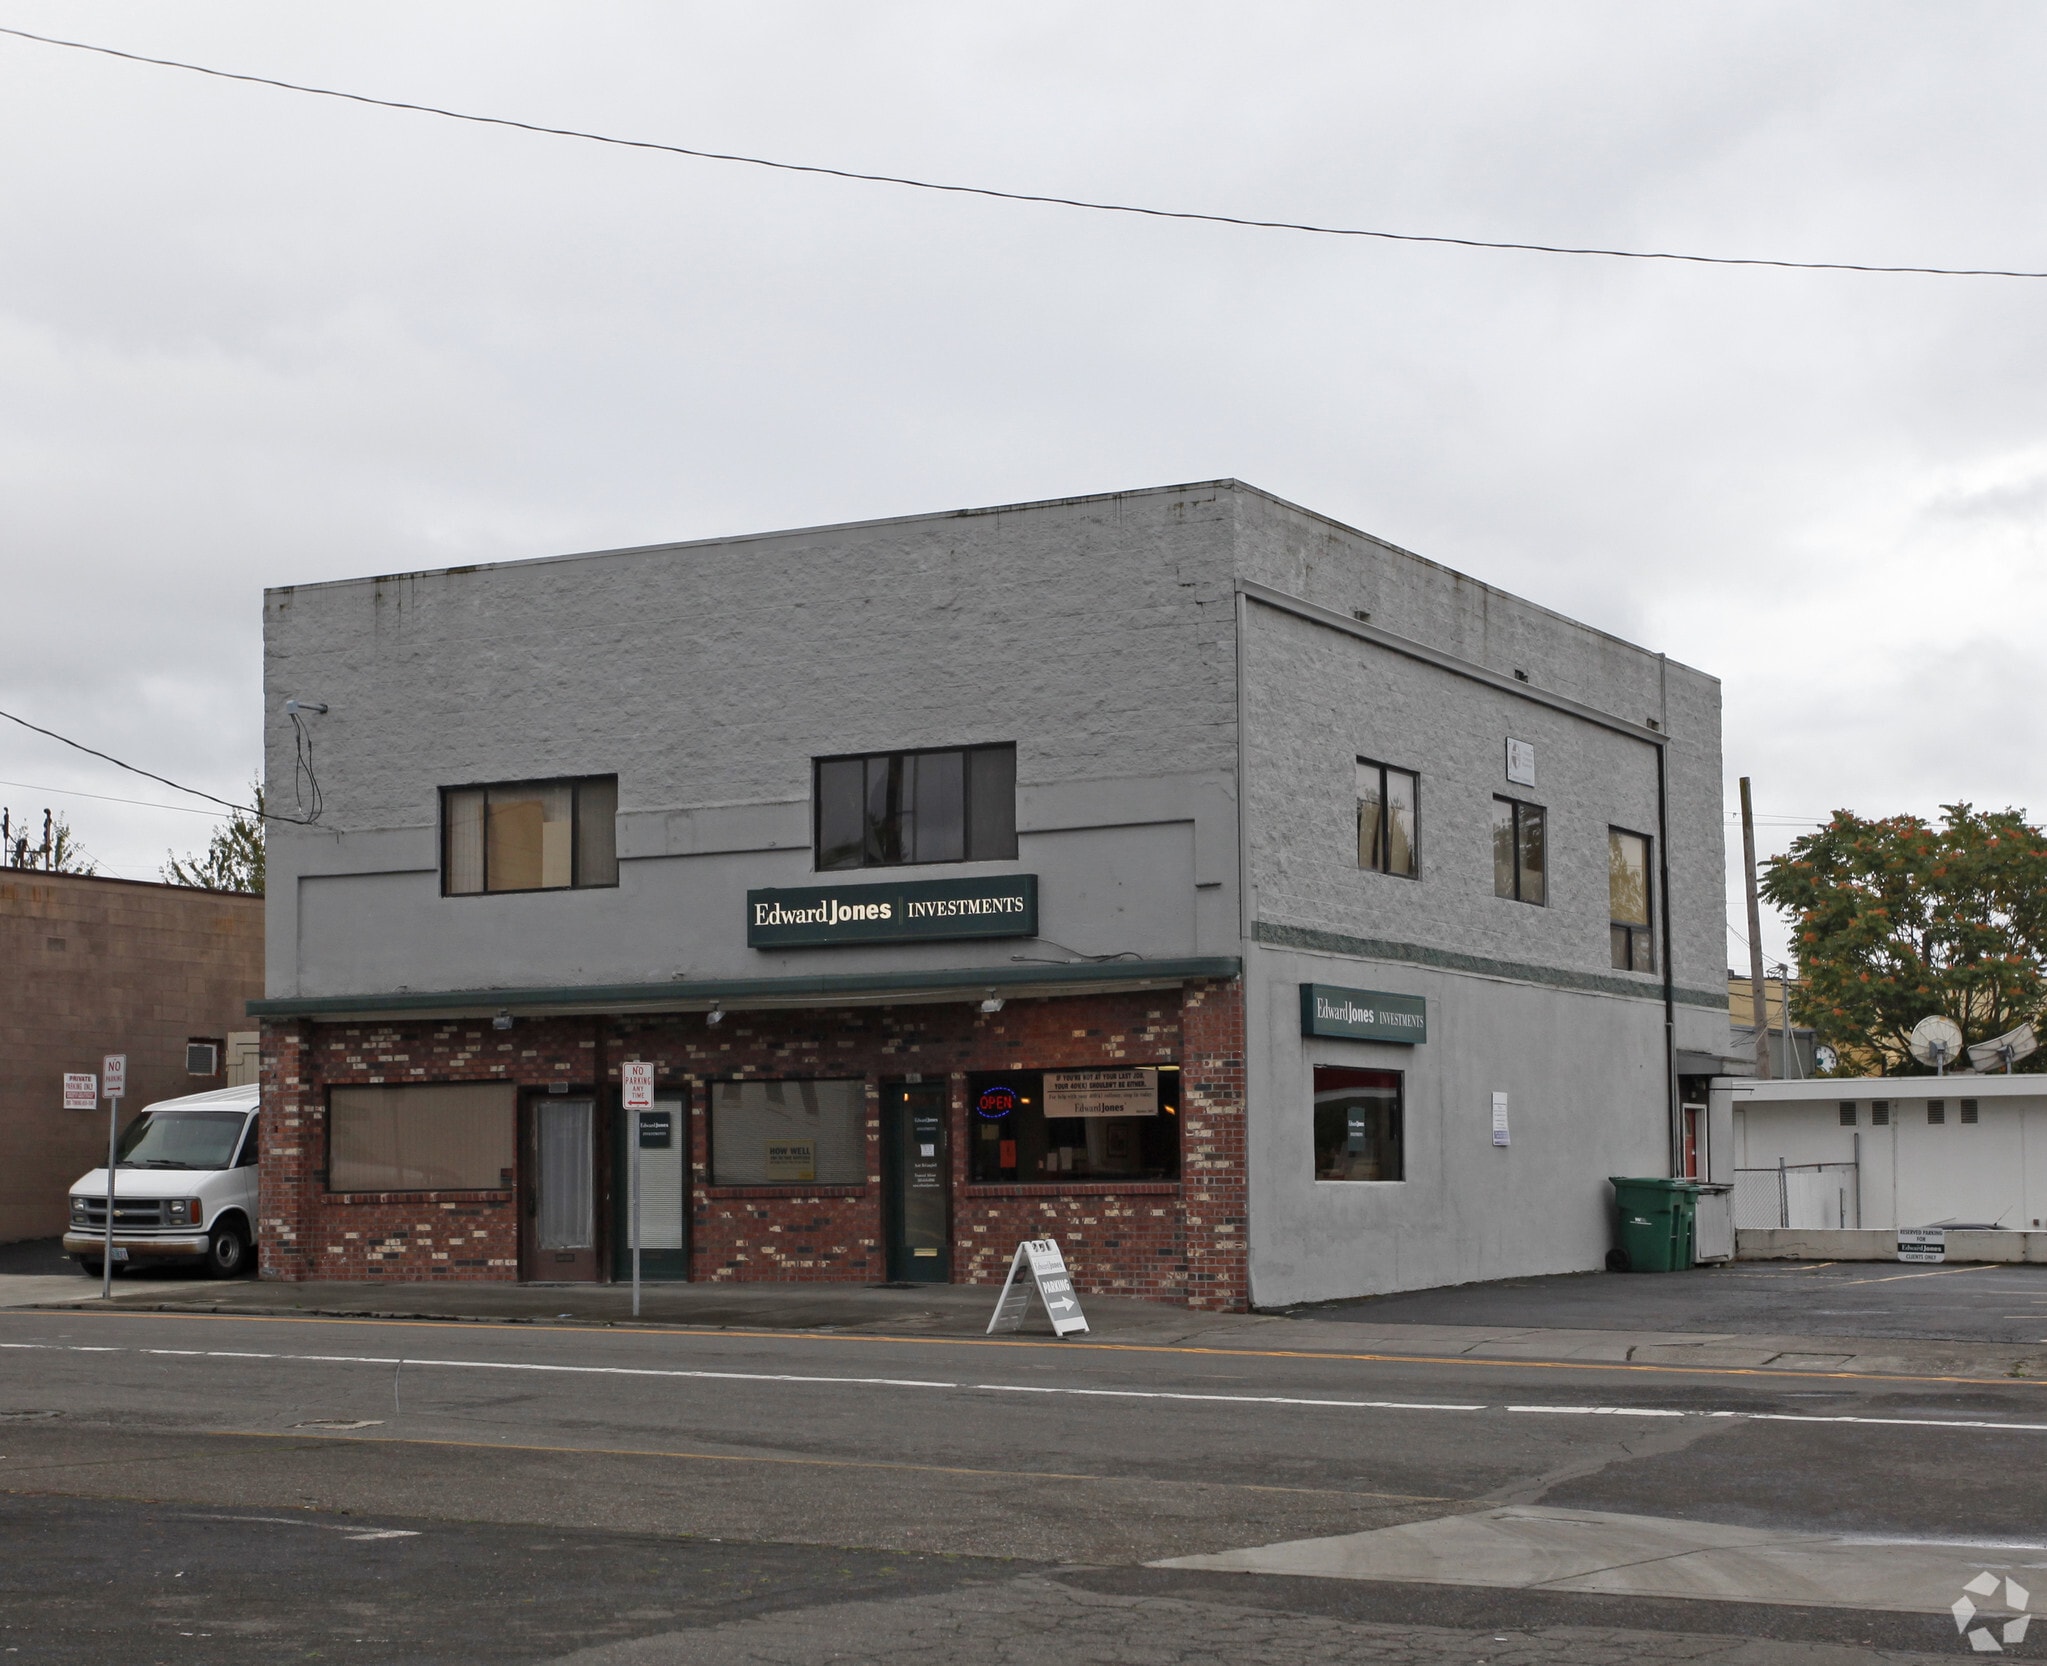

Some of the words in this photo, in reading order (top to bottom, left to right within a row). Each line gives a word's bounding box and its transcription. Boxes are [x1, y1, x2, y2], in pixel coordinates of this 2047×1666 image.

[907, 896, 1024, 918] INVESTMENTS
[1379, 1011, 1424, 1028] INVESTMENTS
[108, 1061, 121, 1071] NO
[632, 1066, 644, 1075] NO
[625, 1077, 651, 1085] PARKING
[1083, 1073, 1093, 1081] NOT
[1118, 1072, 1131, 1080] LAST
[979, 1095, 1013, 1110] OPEN
[769, 1147, 788, 1155] HOW
[790, 1147, 811, 1155] WELL
[1042, 1278, 1070, 1294] PARKING
